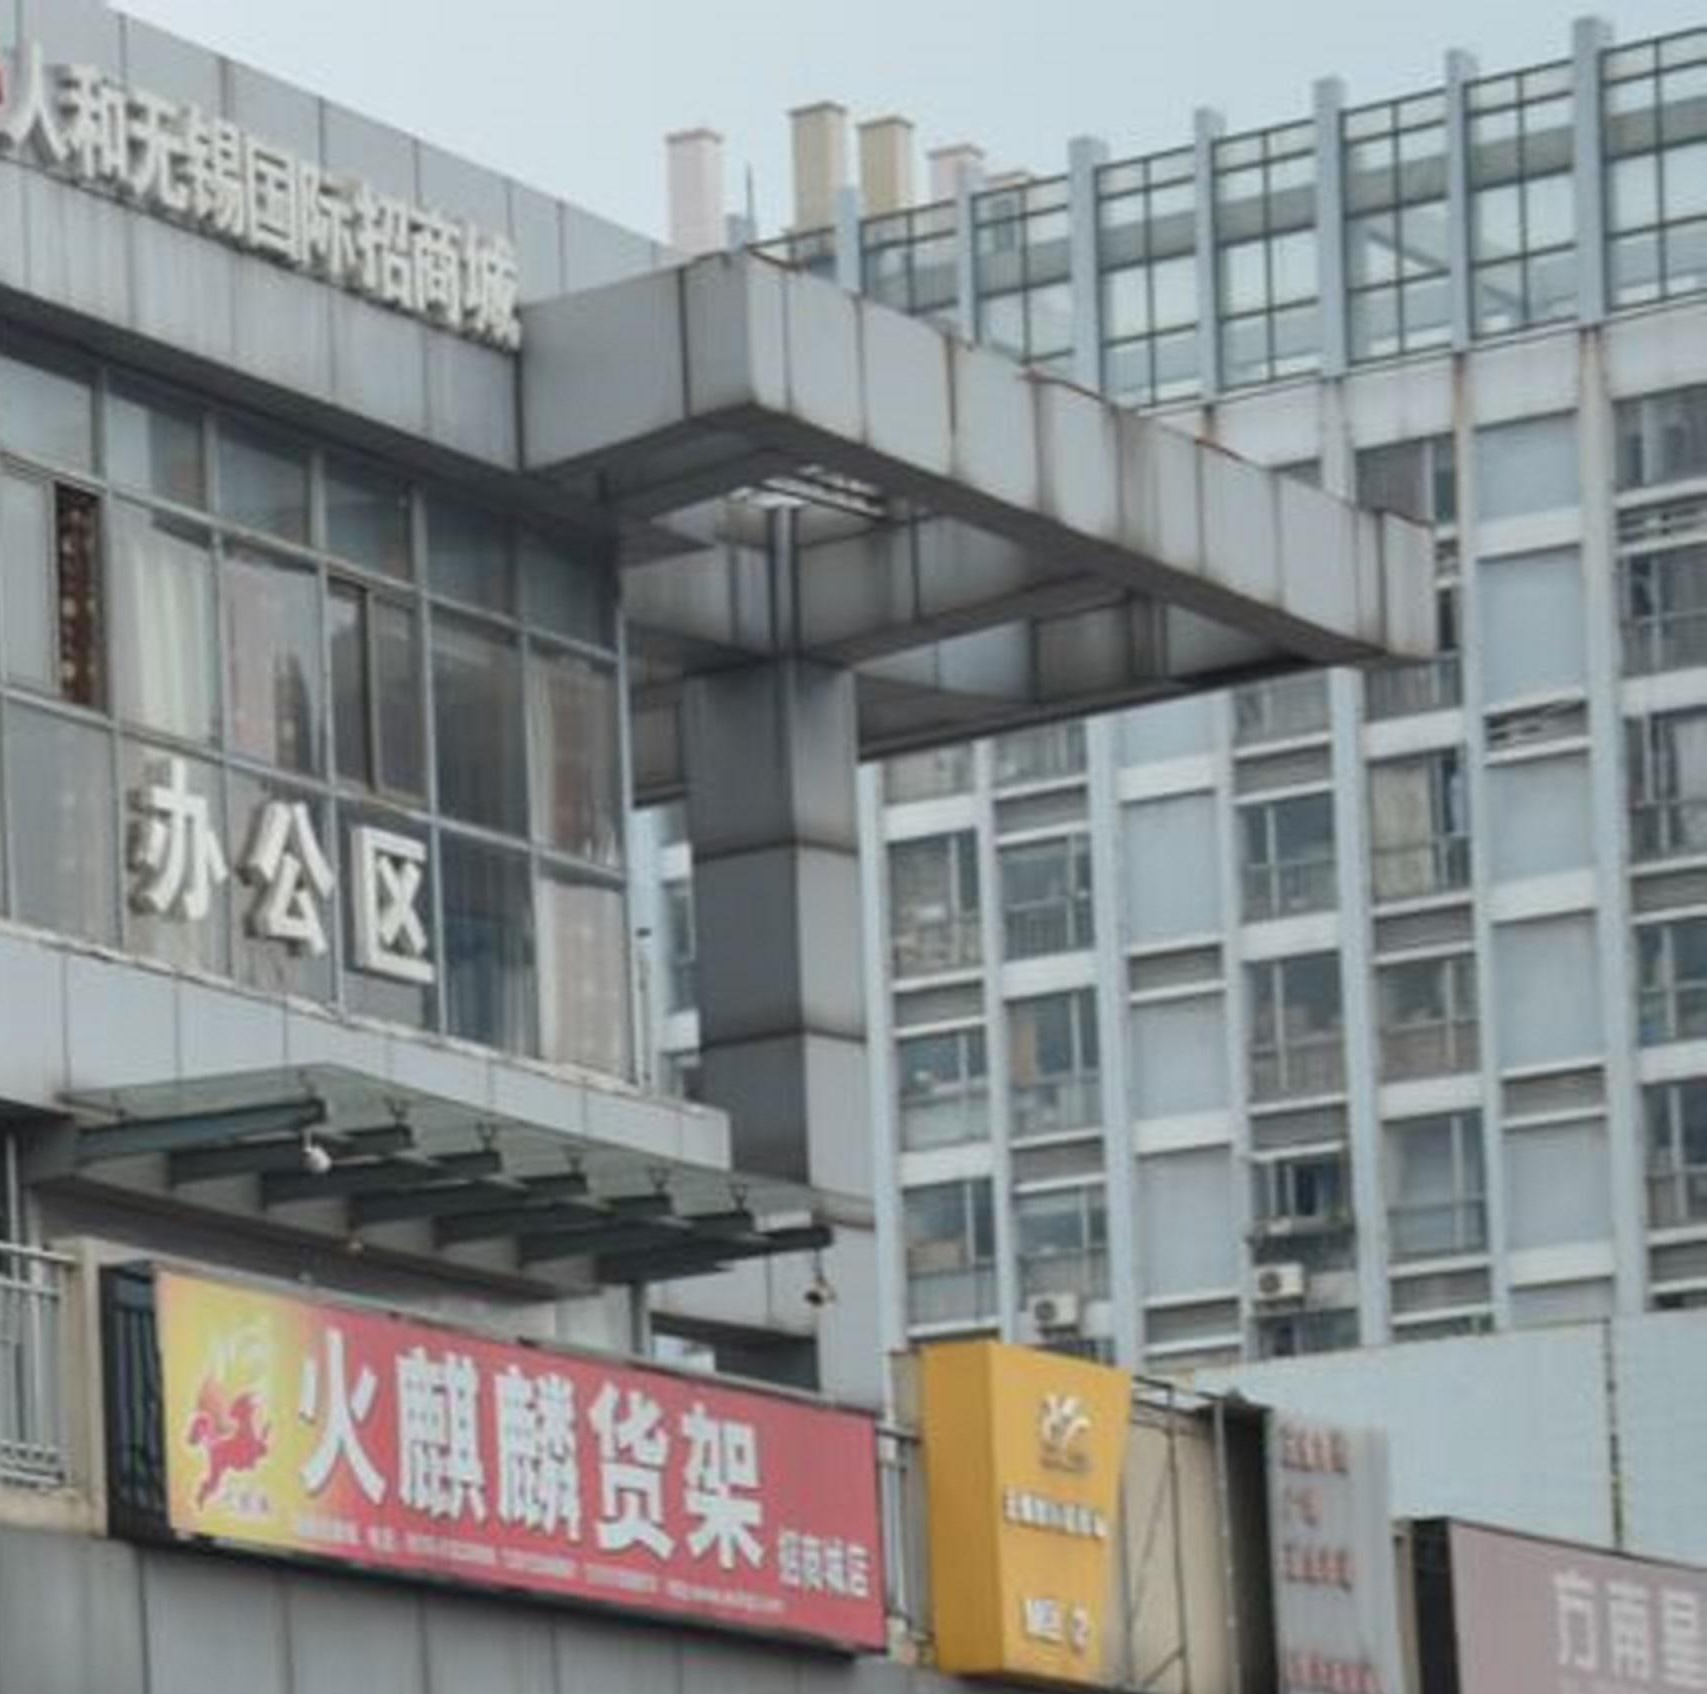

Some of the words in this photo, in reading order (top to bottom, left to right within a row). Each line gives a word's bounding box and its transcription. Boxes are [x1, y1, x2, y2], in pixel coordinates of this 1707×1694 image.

[129, 759, 436, 984] 办公区
[298, 1328, 765, 1570] 火麒麟货架
